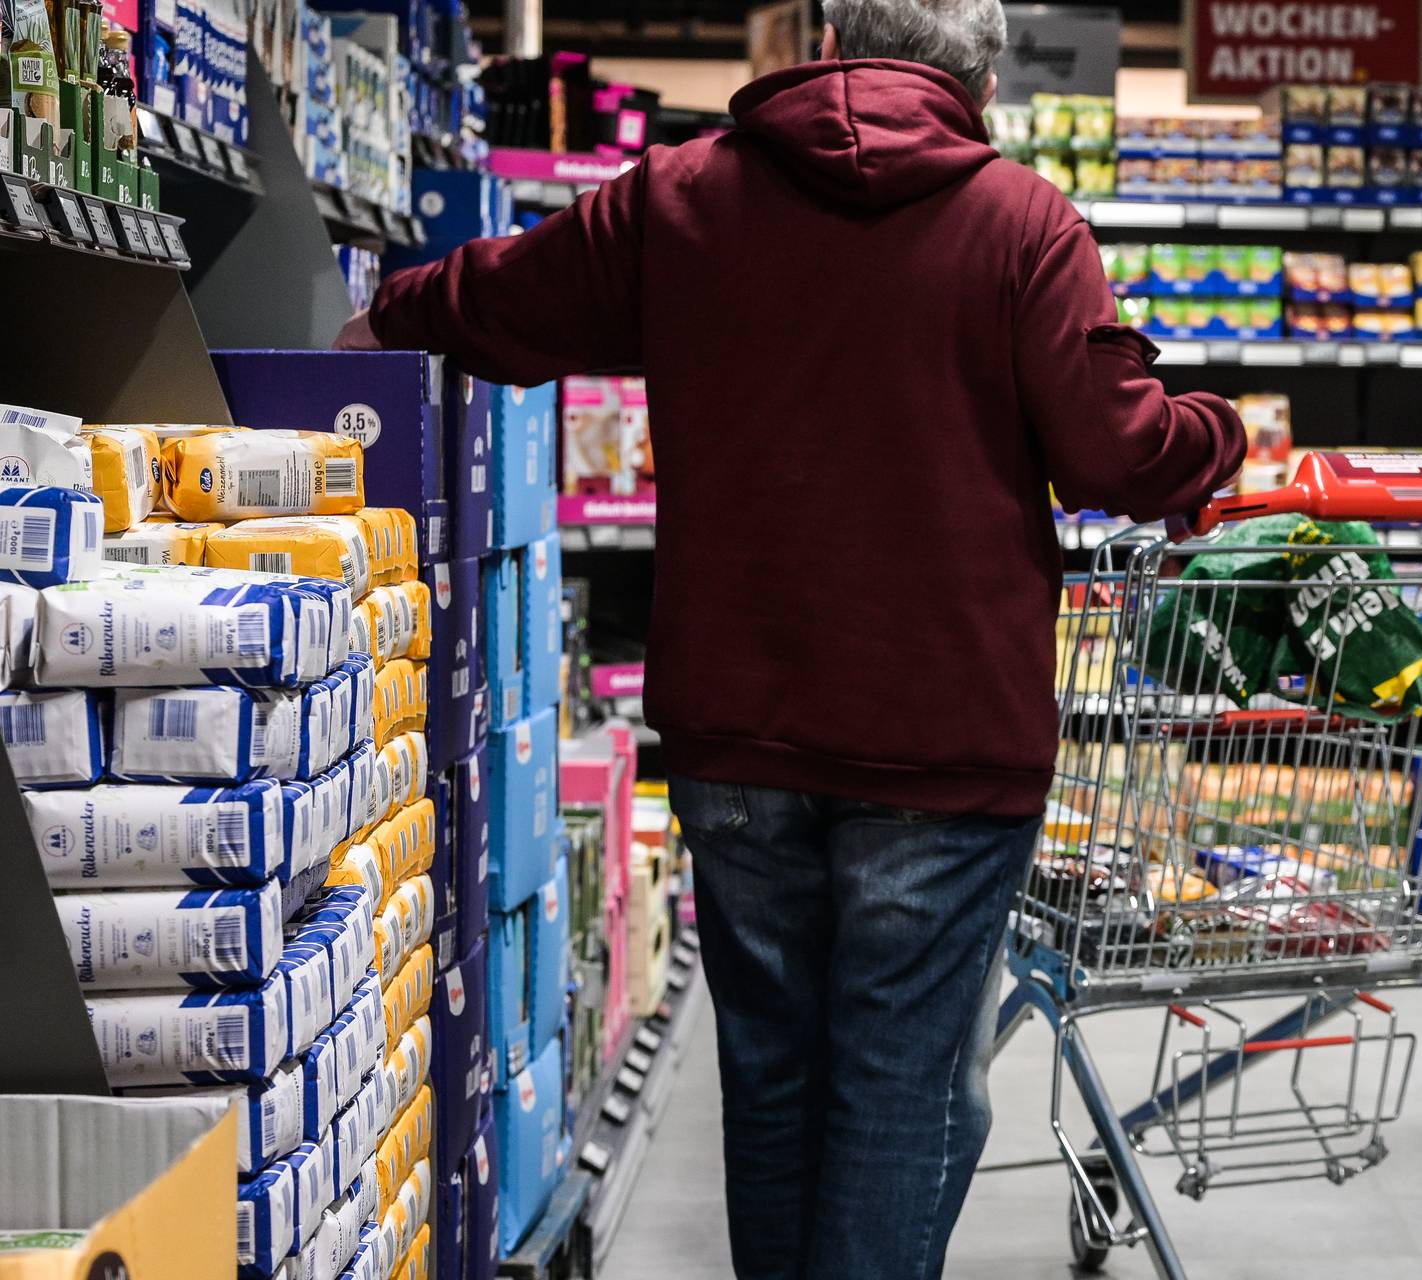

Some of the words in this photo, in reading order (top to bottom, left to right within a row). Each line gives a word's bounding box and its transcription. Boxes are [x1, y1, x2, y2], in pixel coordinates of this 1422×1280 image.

[1211, 3, 1394, 38] WOCHEN-
[22, 60, 40, 71] NATUR
[342, 413, 365, 431] 3,5
[200, 470, 212, 491] Puda
[216, 456, 227, 504] Weizenmehl
[314, 477, 323, 494] 1000
[10, 536, 19, 555] 1000
[100, 600, 117, 677] Rübenzucker
[226, 633, 235, 654] 1000
[81, 801, 98, 878] Rübenzucker
[206, 834, 214, 853] 1000
[78, 905, 96, 983] Rübenzucker
